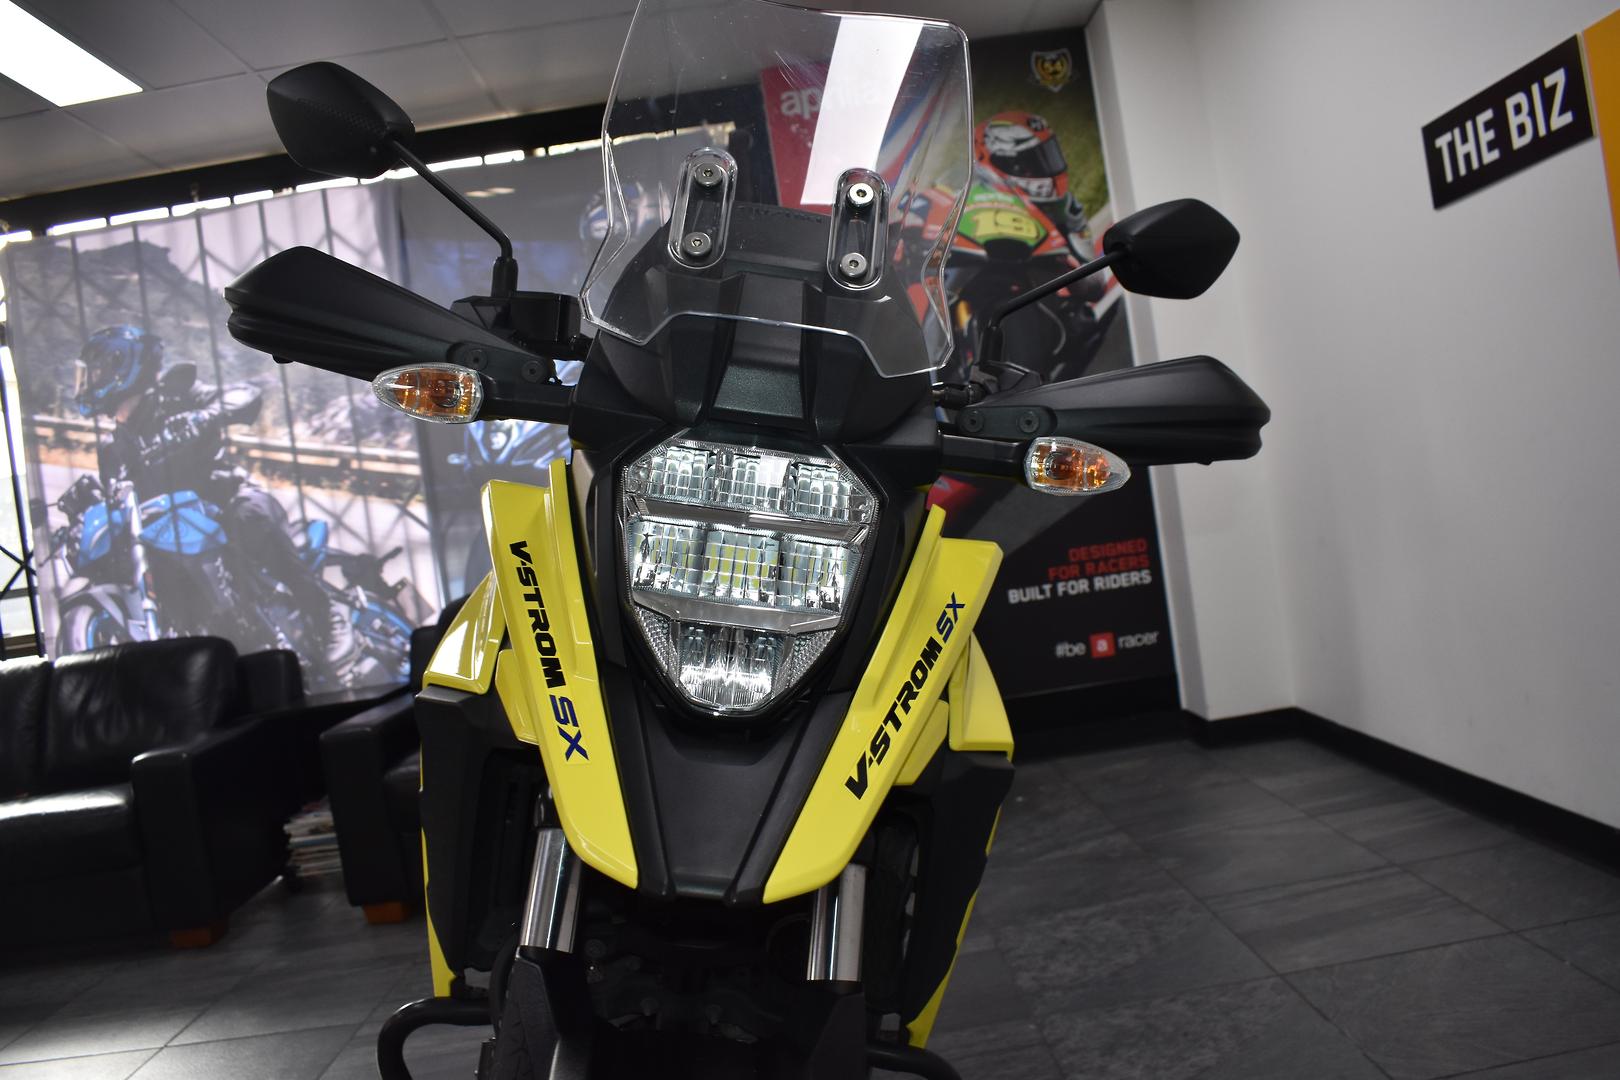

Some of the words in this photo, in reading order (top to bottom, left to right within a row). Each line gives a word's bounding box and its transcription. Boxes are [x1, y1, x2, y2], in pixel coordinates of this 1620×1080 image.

[1435, 107, 1500, 184] THE
[1505, 67, 1574, 151] BIZ
[1047, 564, 1080, 581] FOR
[1085, 554, 1150, 576] RACERS
[1068, 538, 1148, 562] DESIGNED
[1007, 583, 1053, 604] BUILT
[1056, 577, 1090, 598] FOR
[1093, 568, 1153, 591] RIDERS
[936, 591, 966, 644] SX
[1117, 630, 1159, 649] racer
[549, 693, 590, 762] SX
